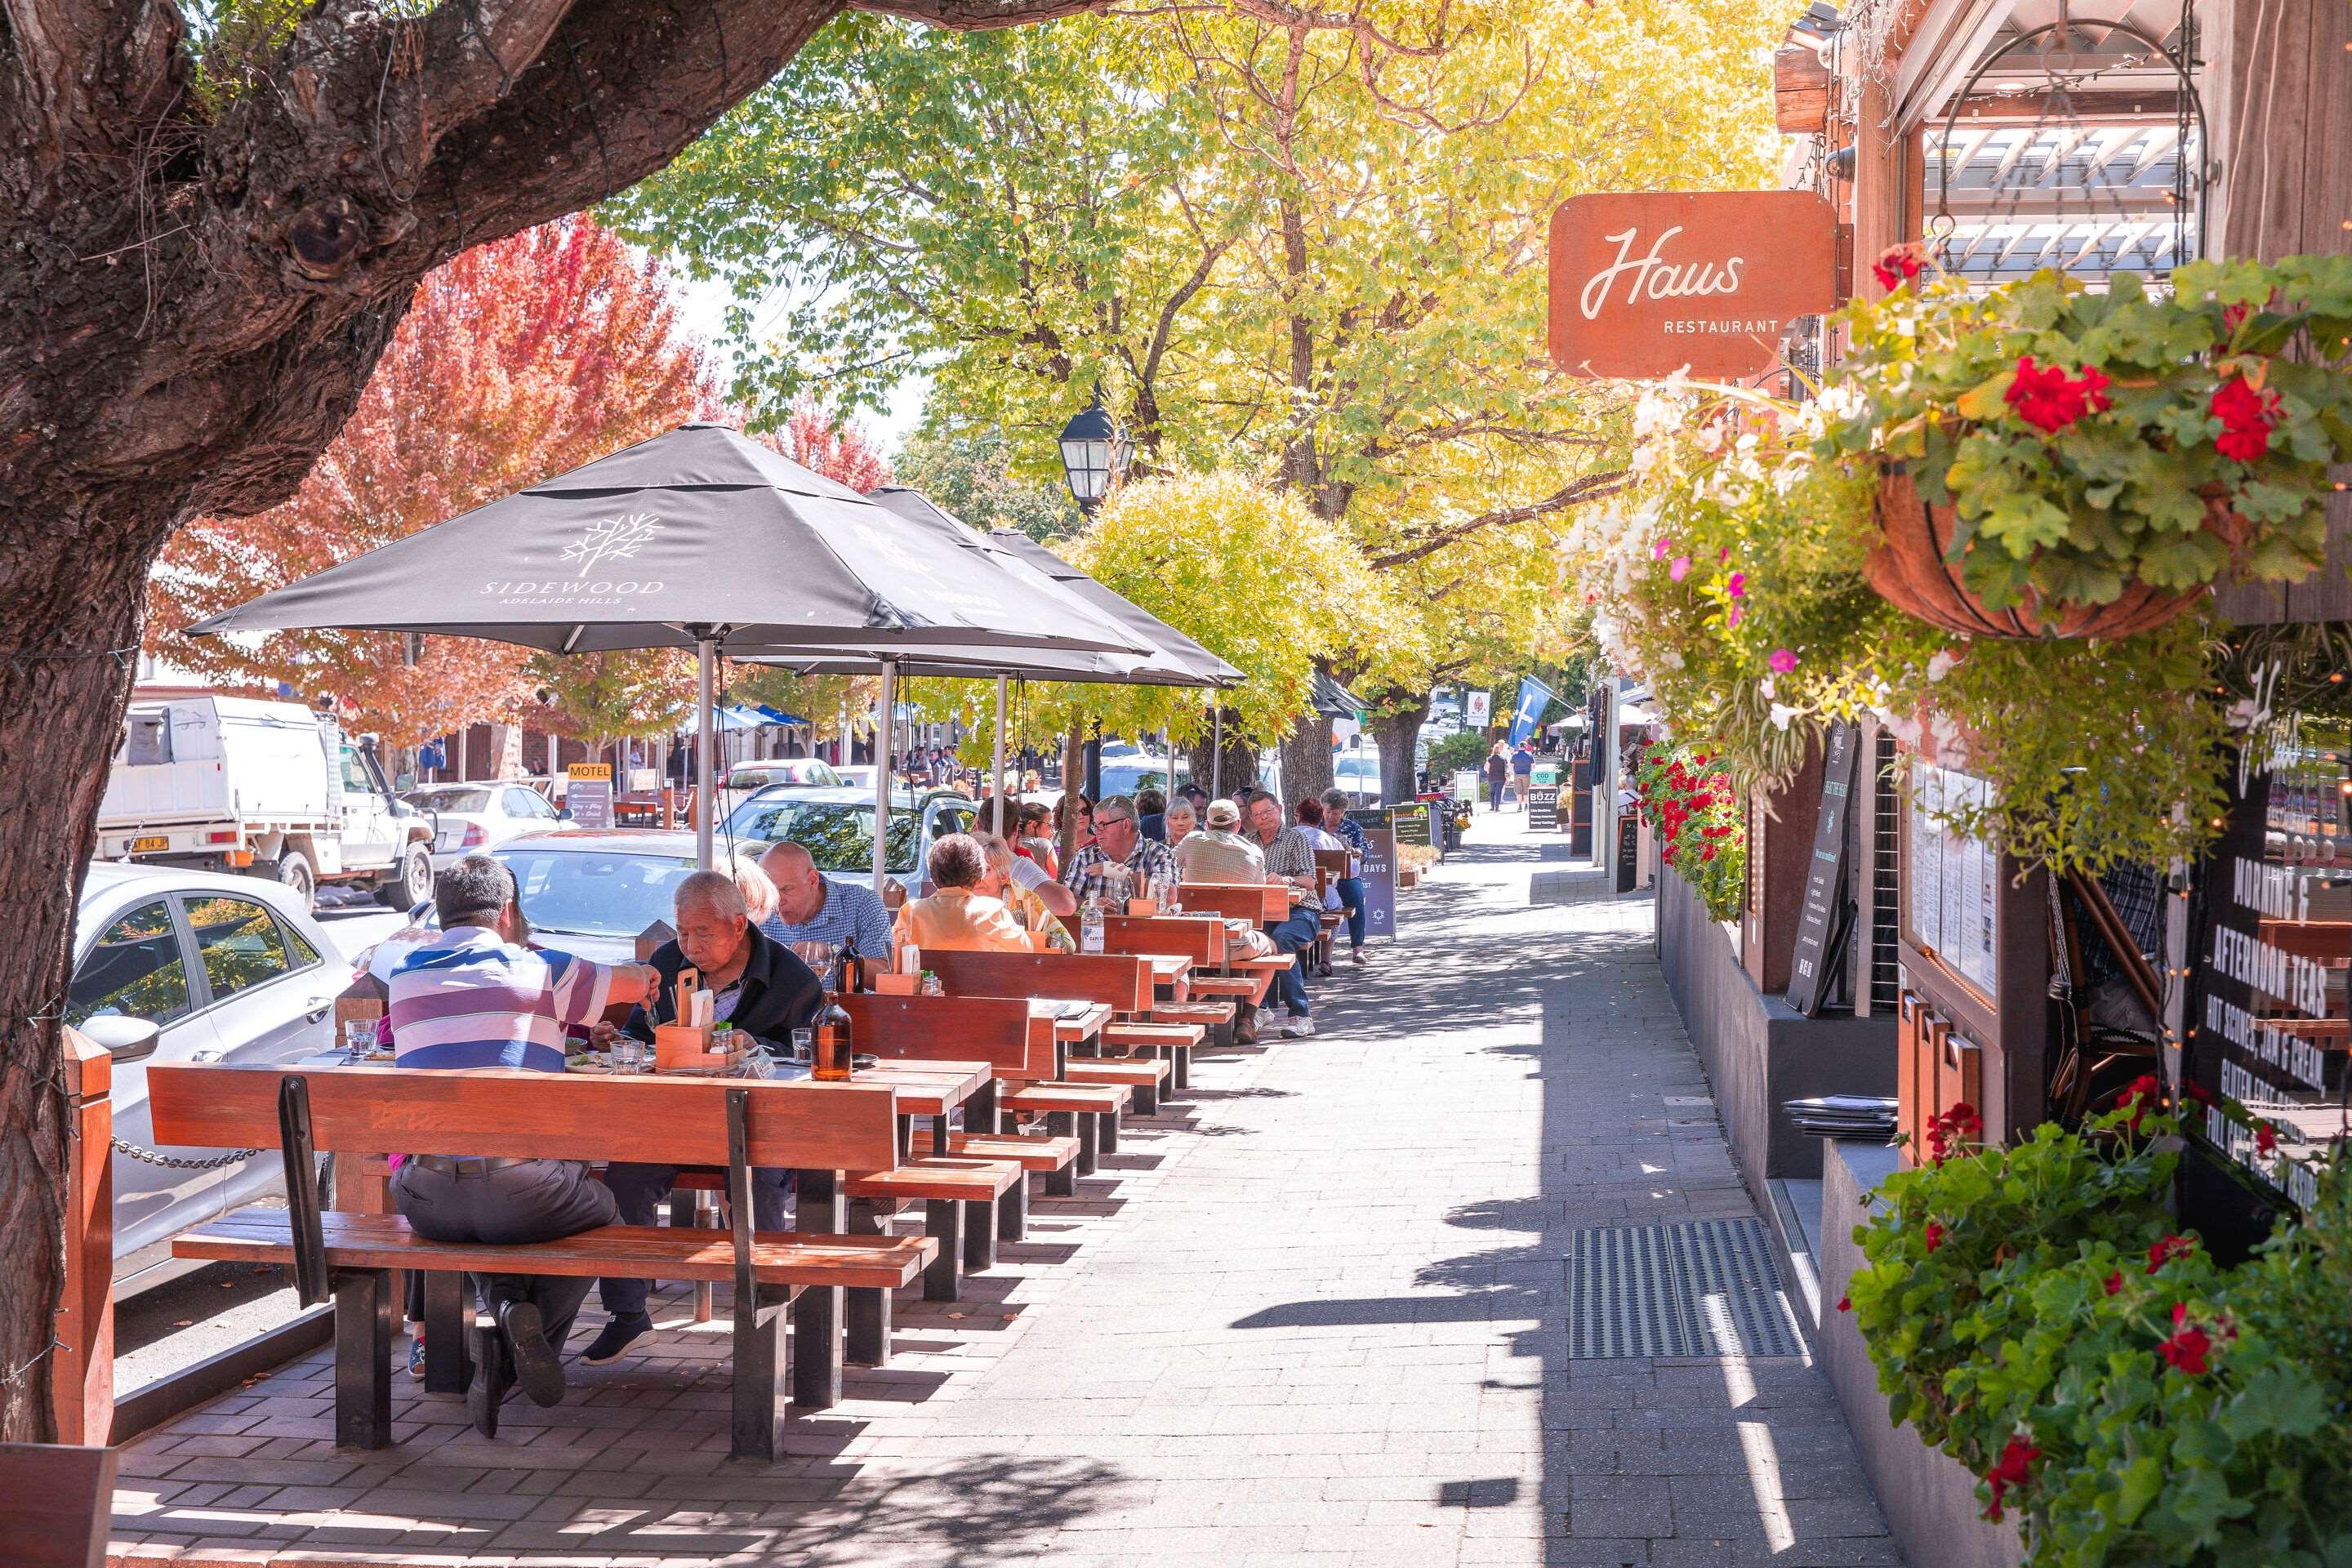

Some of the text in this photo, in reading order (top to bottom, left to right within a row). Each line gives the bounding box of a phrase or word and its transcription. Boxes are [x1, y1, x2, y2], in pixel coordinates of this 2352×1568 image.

[1581, 225, 1744, 320] Haus
[1663, 319, 1778, 334] RESTAURANT
[479, 581, 665, 595] SIDEWOOD
[570, 766, 609, 777] MOTEL
[1530, 792, 1556, 801] BUZZ
[2234, 856, 2295, 920] MORNING
[2213, 924, 2328, 1019] AFTERNOON TEAS
[2206, 993, 2224, 1035] HOT
[2224, 1001, 2259, 1060] SCONES,
[2260, 1022, 2280, 1066] JAM
[2291, 1036, 2327, 1099] CREAM,
